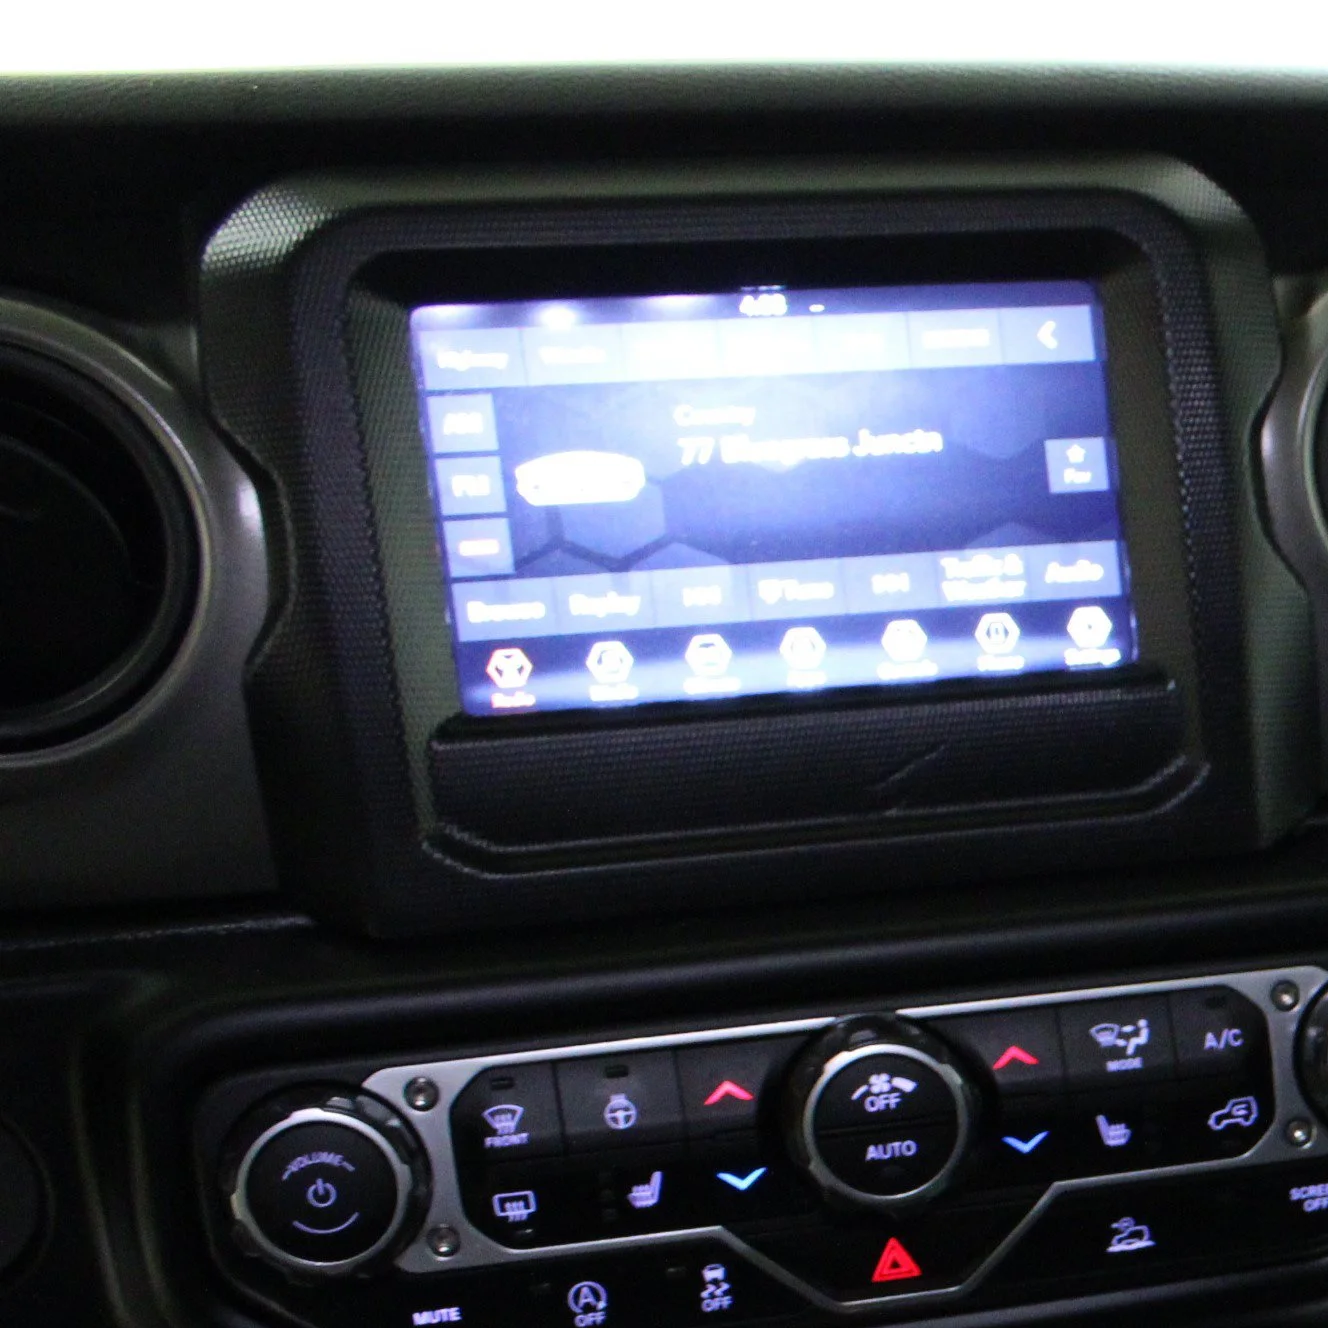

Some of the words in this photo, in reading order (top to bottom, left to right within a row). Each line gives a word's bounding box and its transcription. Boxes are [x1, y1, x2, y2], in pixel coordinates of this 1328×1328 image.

[1204, 1028, 1244, 1051] A/C
[1105, 1057, 1144, 1073] MODE
[864, 1094, 902, 1112] OFF
[484, 1132, 530, 1149] FRONT
[865, 1140, 918, 1162] AUTO
[701, 1298, 734, 1313] OFF
[412, 1307, 463, 1327] MUTE
[574, 1312, 608, 1328] OFF
